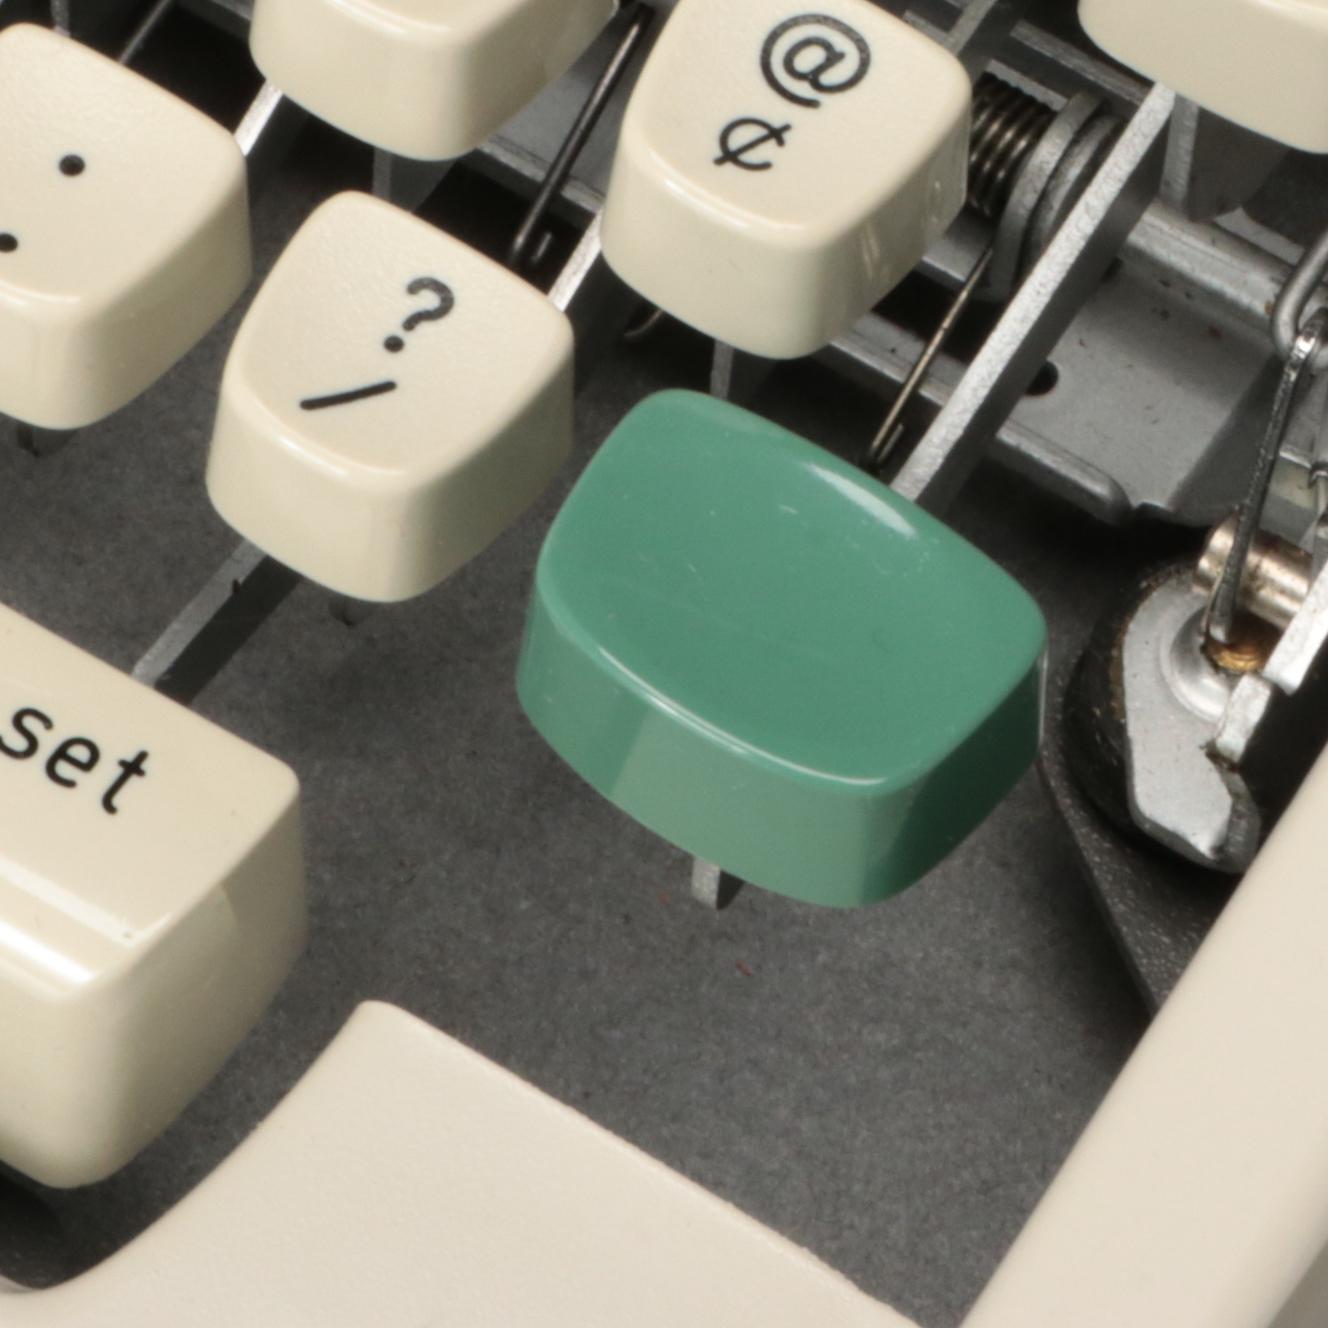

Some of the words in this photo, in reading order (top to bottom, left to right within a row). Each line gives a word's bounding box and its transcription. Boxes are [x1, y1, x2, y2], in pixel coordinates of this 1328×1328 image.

[759, 13, 871, 109] @
[383, 275, 456, 354] ?
[0, 705, 150, 816] set
